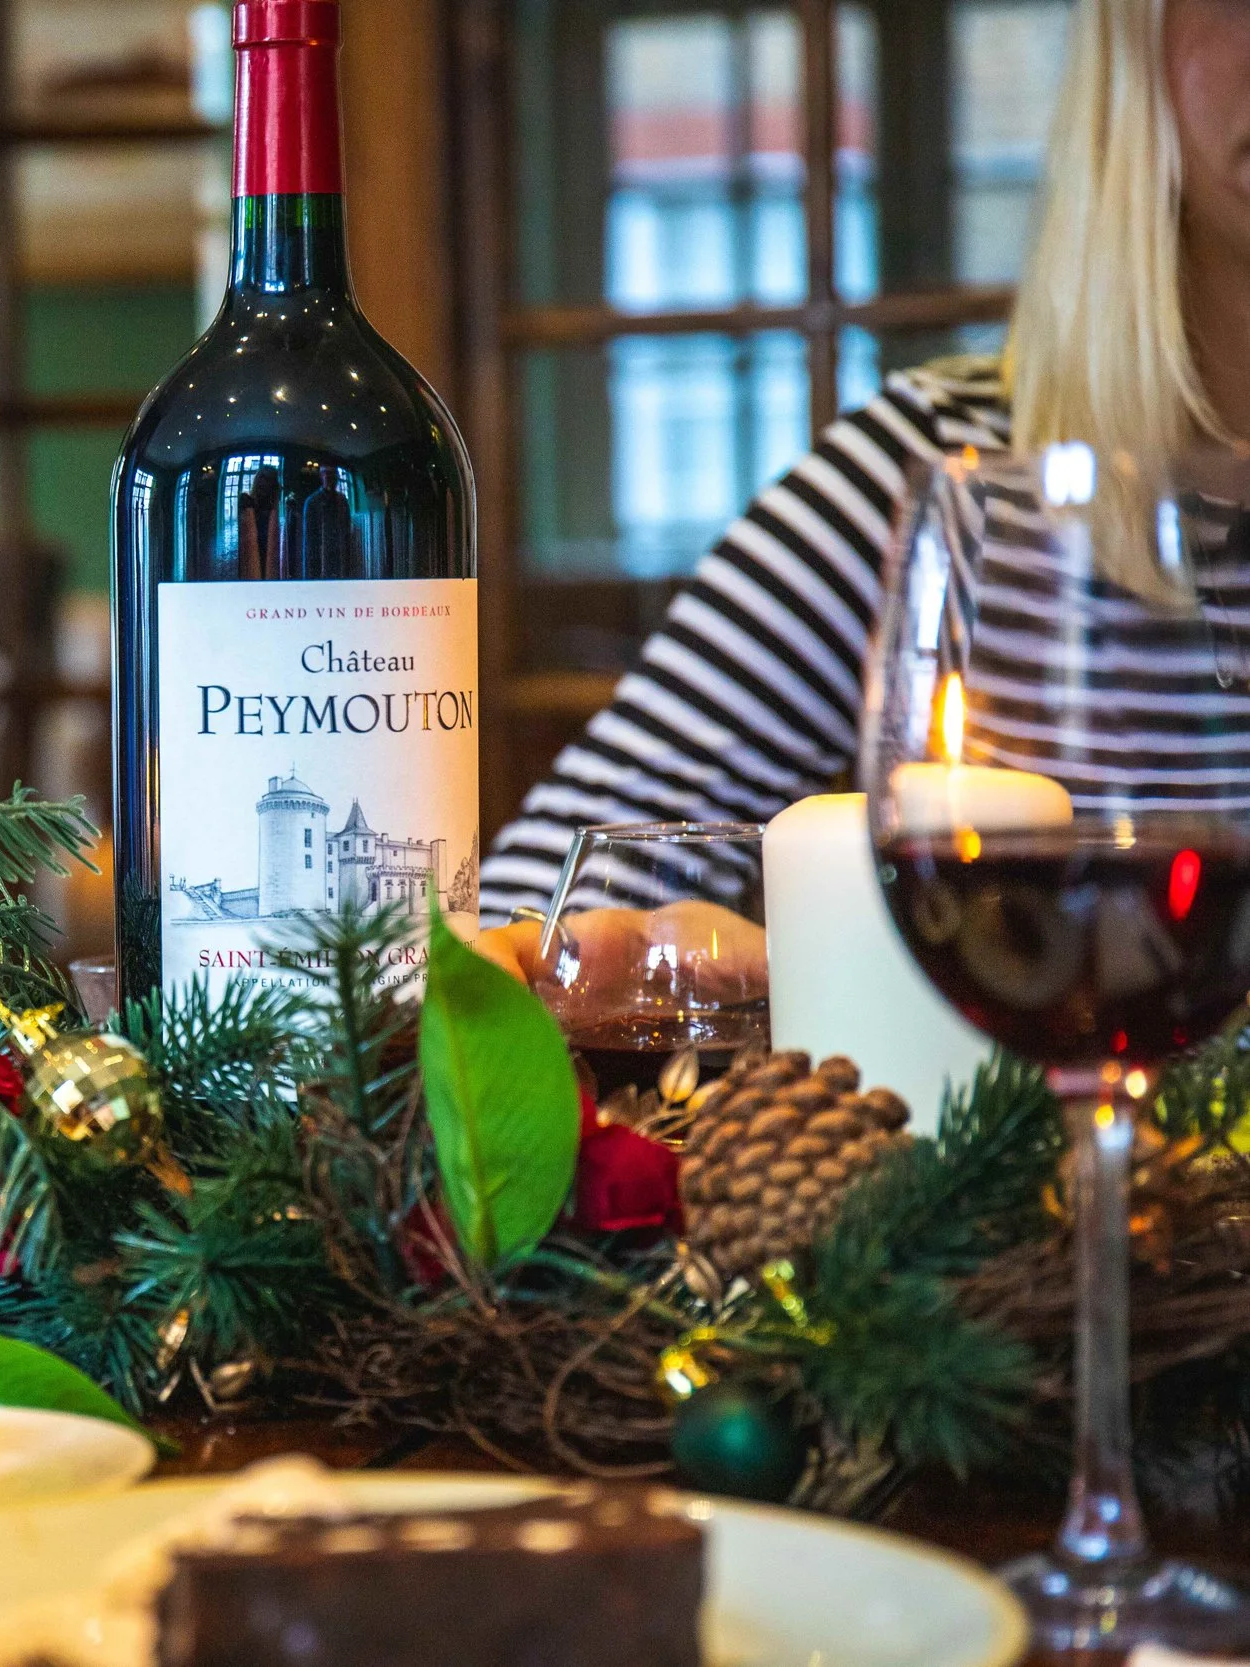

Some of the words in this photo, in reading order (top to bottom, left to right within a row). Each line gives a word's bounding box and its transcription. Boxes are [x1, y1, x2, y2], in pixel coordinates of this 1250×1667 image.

[246, 607, 307, 620] GRAND
[316, 607, 346, 619] VIN
[354, 606, 375, 618] DE
[381, 605, 451, 618] BORDEAUX
[301, 640, 415, 674] Château
[197, 684, 473, 736] PEYMOUTON
[387, 945, 430, 966] GRA
